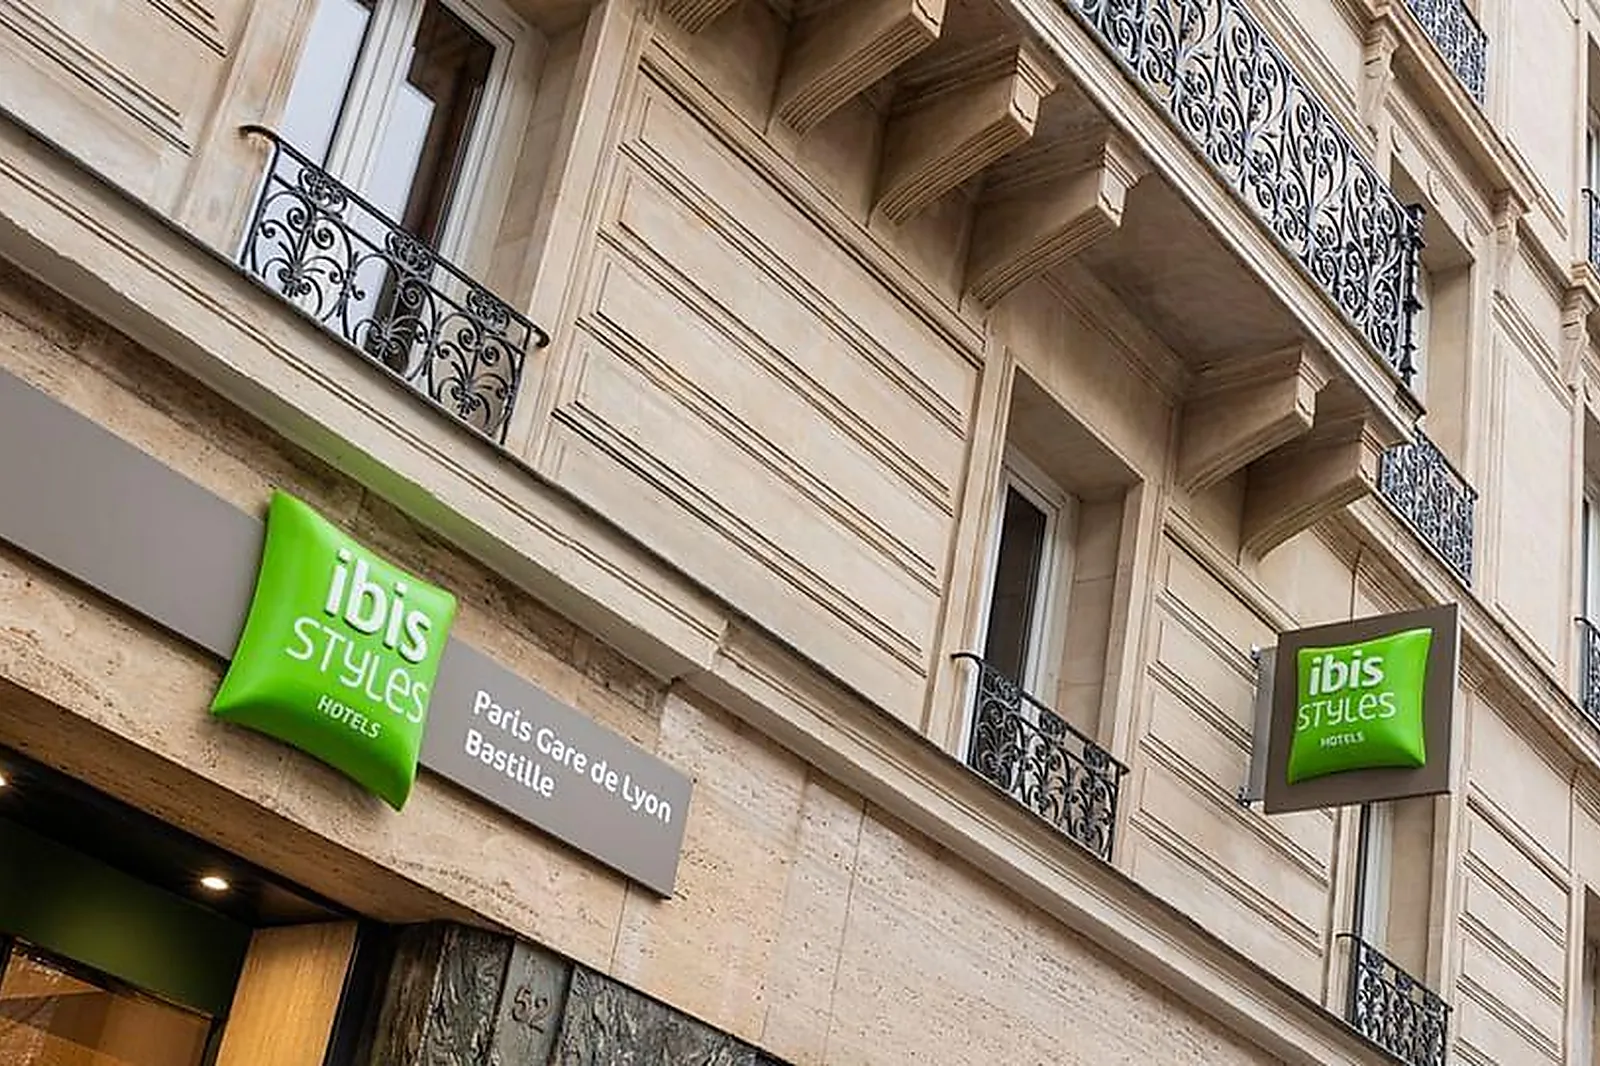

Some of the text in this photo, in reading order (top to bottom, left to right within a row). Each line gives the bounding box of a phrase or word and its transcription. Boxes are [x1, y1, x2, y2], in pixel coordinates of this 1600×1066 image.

[325, 547, 432, 664] ibis
[1308, 649, 1385, 697] ibis
[316, 694, 382, 740] HOTELS
[1320, 731, 1365, 748] HOTELS
[464, 729, 556, 798] Bastille
[473, 690, 673, 824] Paris Gare de Lyon
[511, 983, 549, 1034] 52
